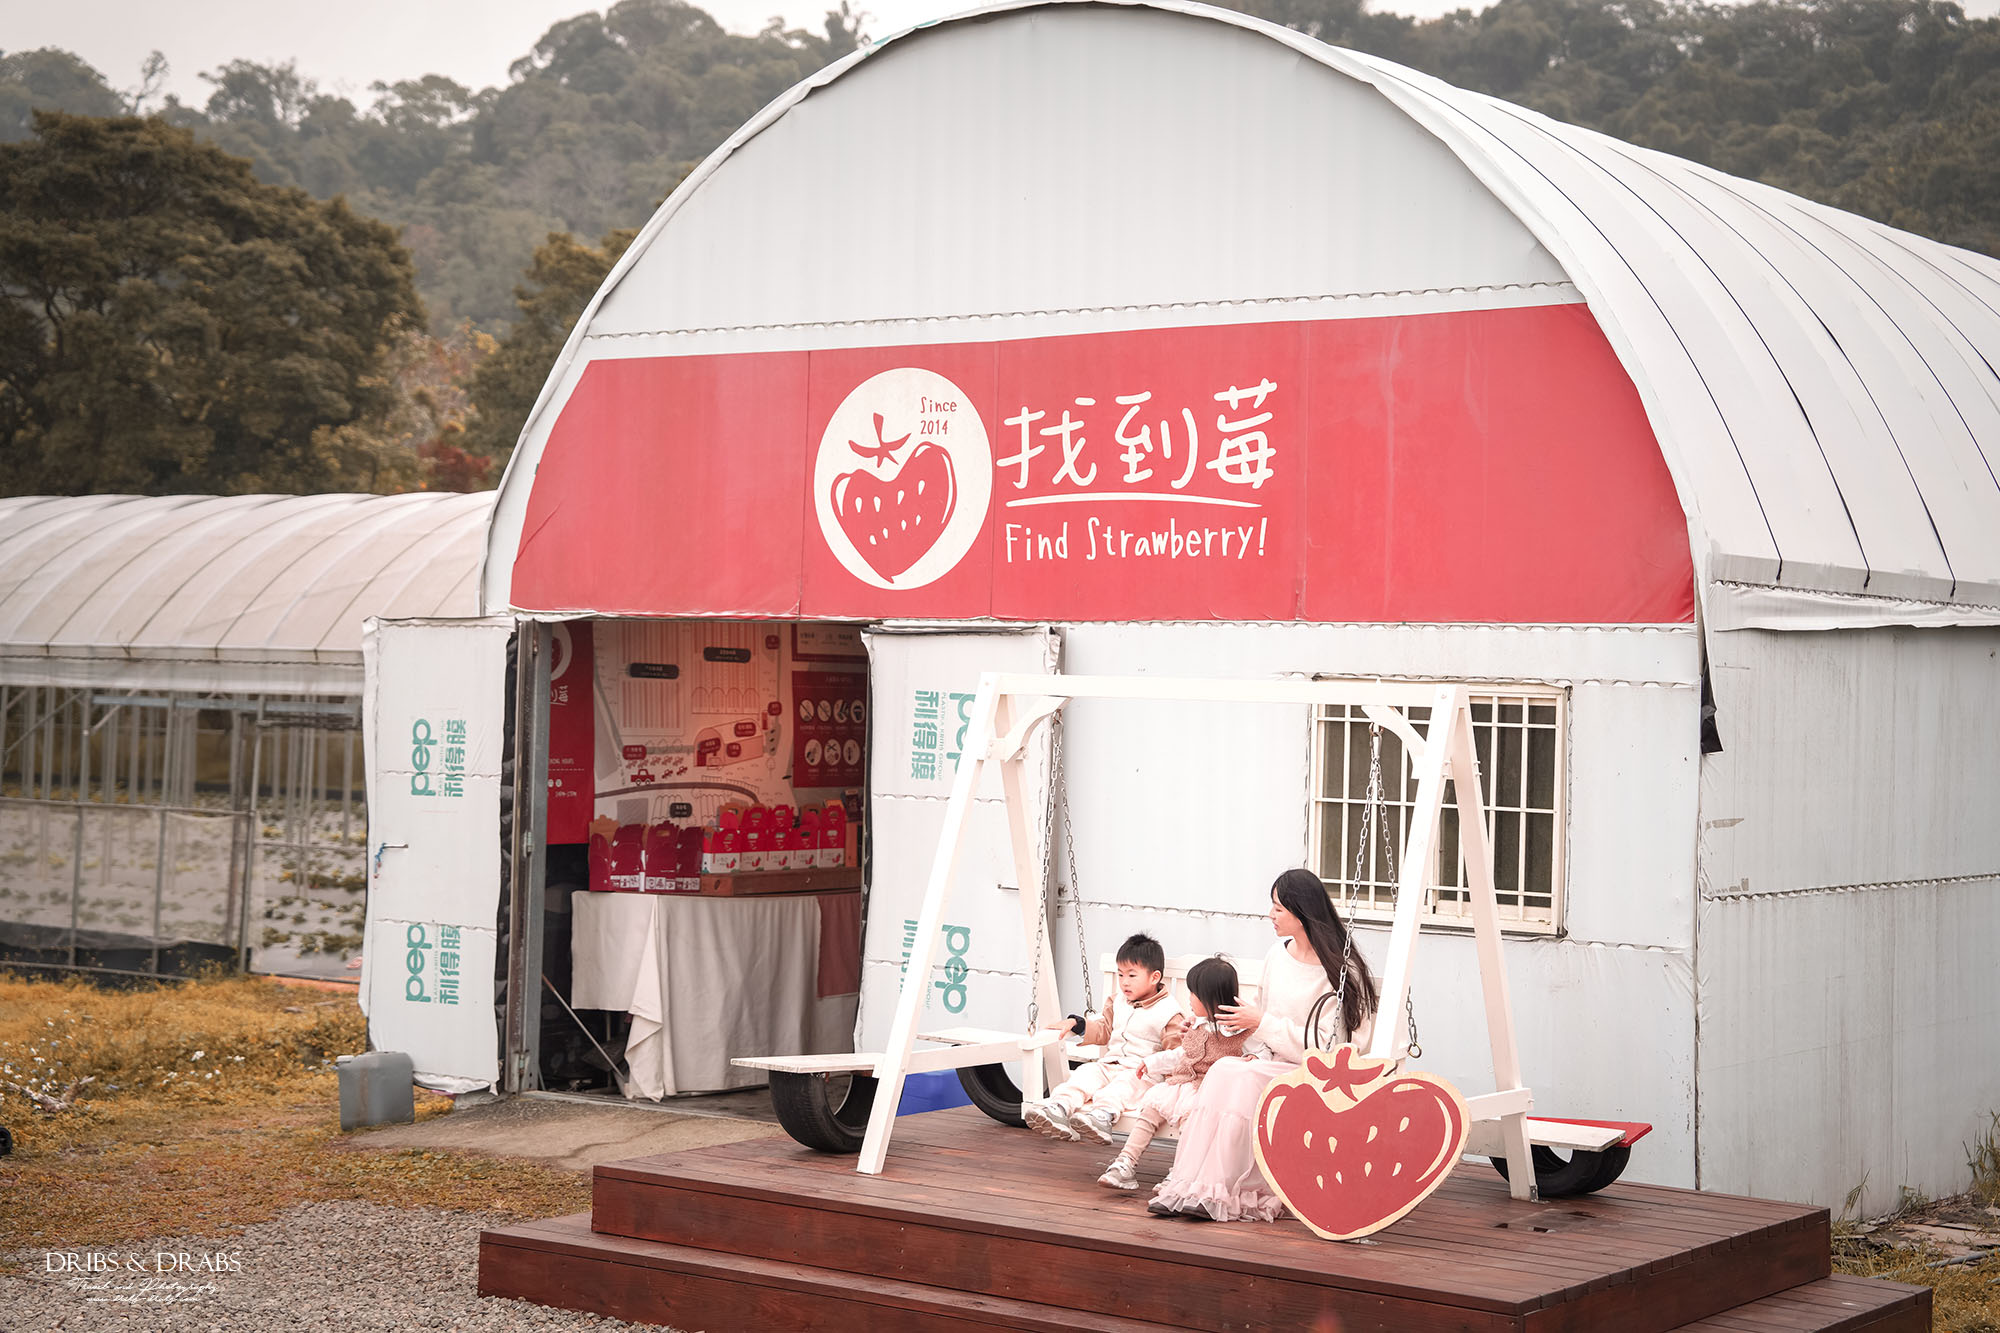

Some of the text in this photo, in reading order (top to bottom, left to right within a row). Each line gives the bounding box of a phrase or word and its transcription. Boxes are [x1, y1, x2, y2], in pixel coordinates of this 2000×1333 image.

[919, 396, 958, 414] Since
[919, 418, 950, 436] 2014
[996, 377, 1278, 490] 找到莓
[1005, 516, 1268, 563] Find Strawberry!
[411, 719, 437, 796] pep
[444, 720, 466, 797] 利得膜
[911, 689, 939, 781] 利得膜
[406, 925, 432, 1002] pep
[440, 926, 460, 1005] 利得膜
[935, 924, 971, 1013] pep
